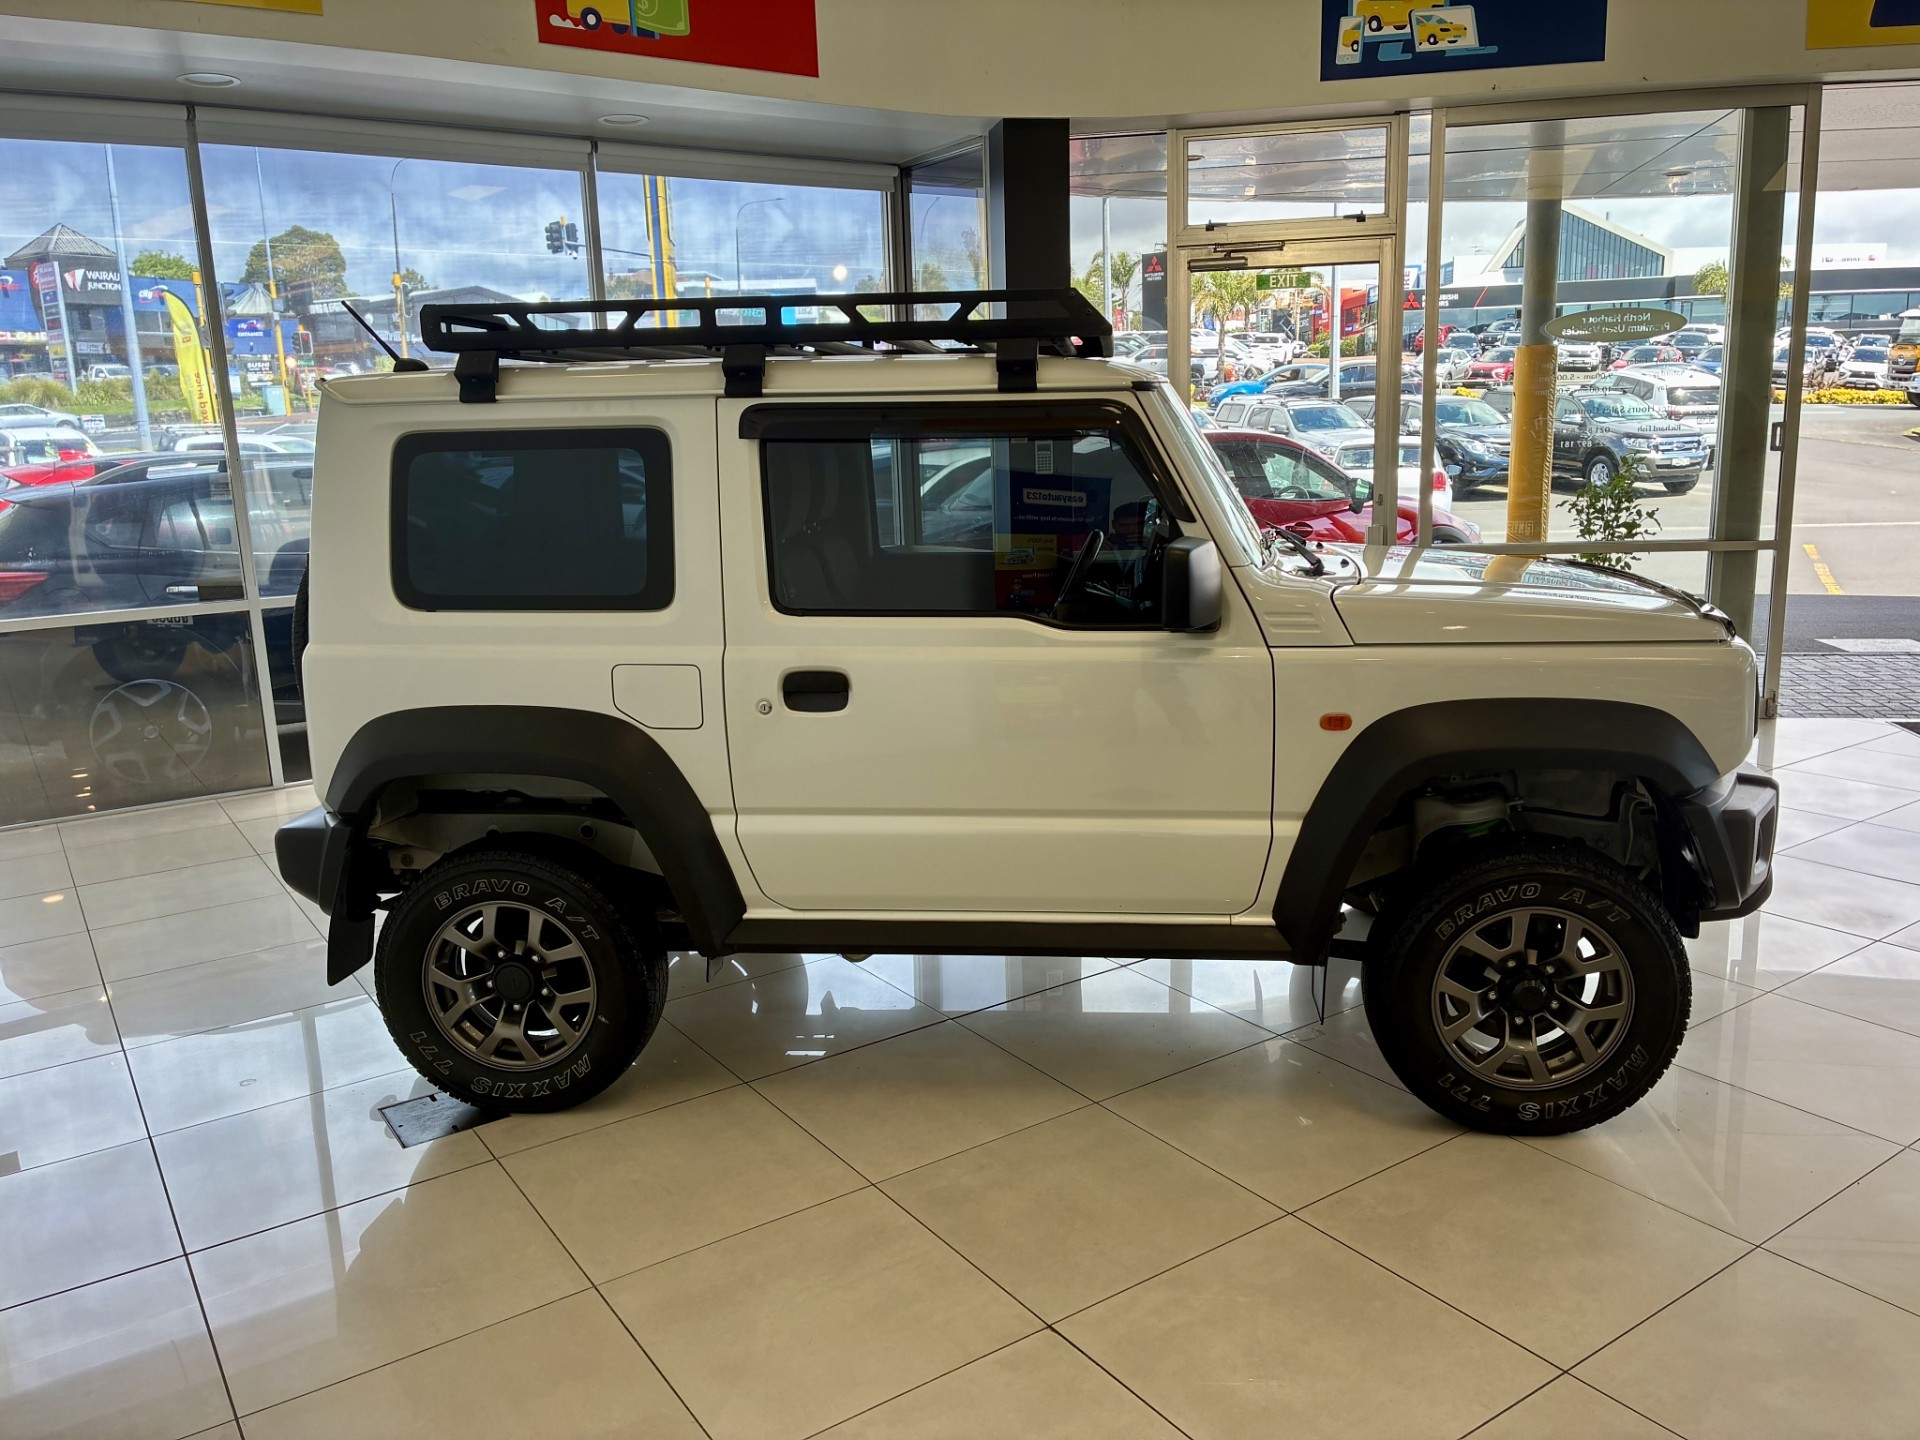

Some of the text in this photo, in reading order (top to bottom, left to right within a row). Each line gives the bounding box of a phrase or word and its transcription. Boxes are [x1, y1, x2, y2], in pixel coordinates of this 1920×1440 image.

[86, 270, 120, 281] WAIRAU
[87, 282, 122, 291] JUNCTION
[1269, 275, 1299, 288] EXIT
[434, 879, 600, 941] BRAVO A/T
[1436, 883, 1631, 940] BRAVO A/T
[409, 1030, 592, 1098] MAXXIS 771
[1438, 1044, 1649, 1121] MAXXIS 771
